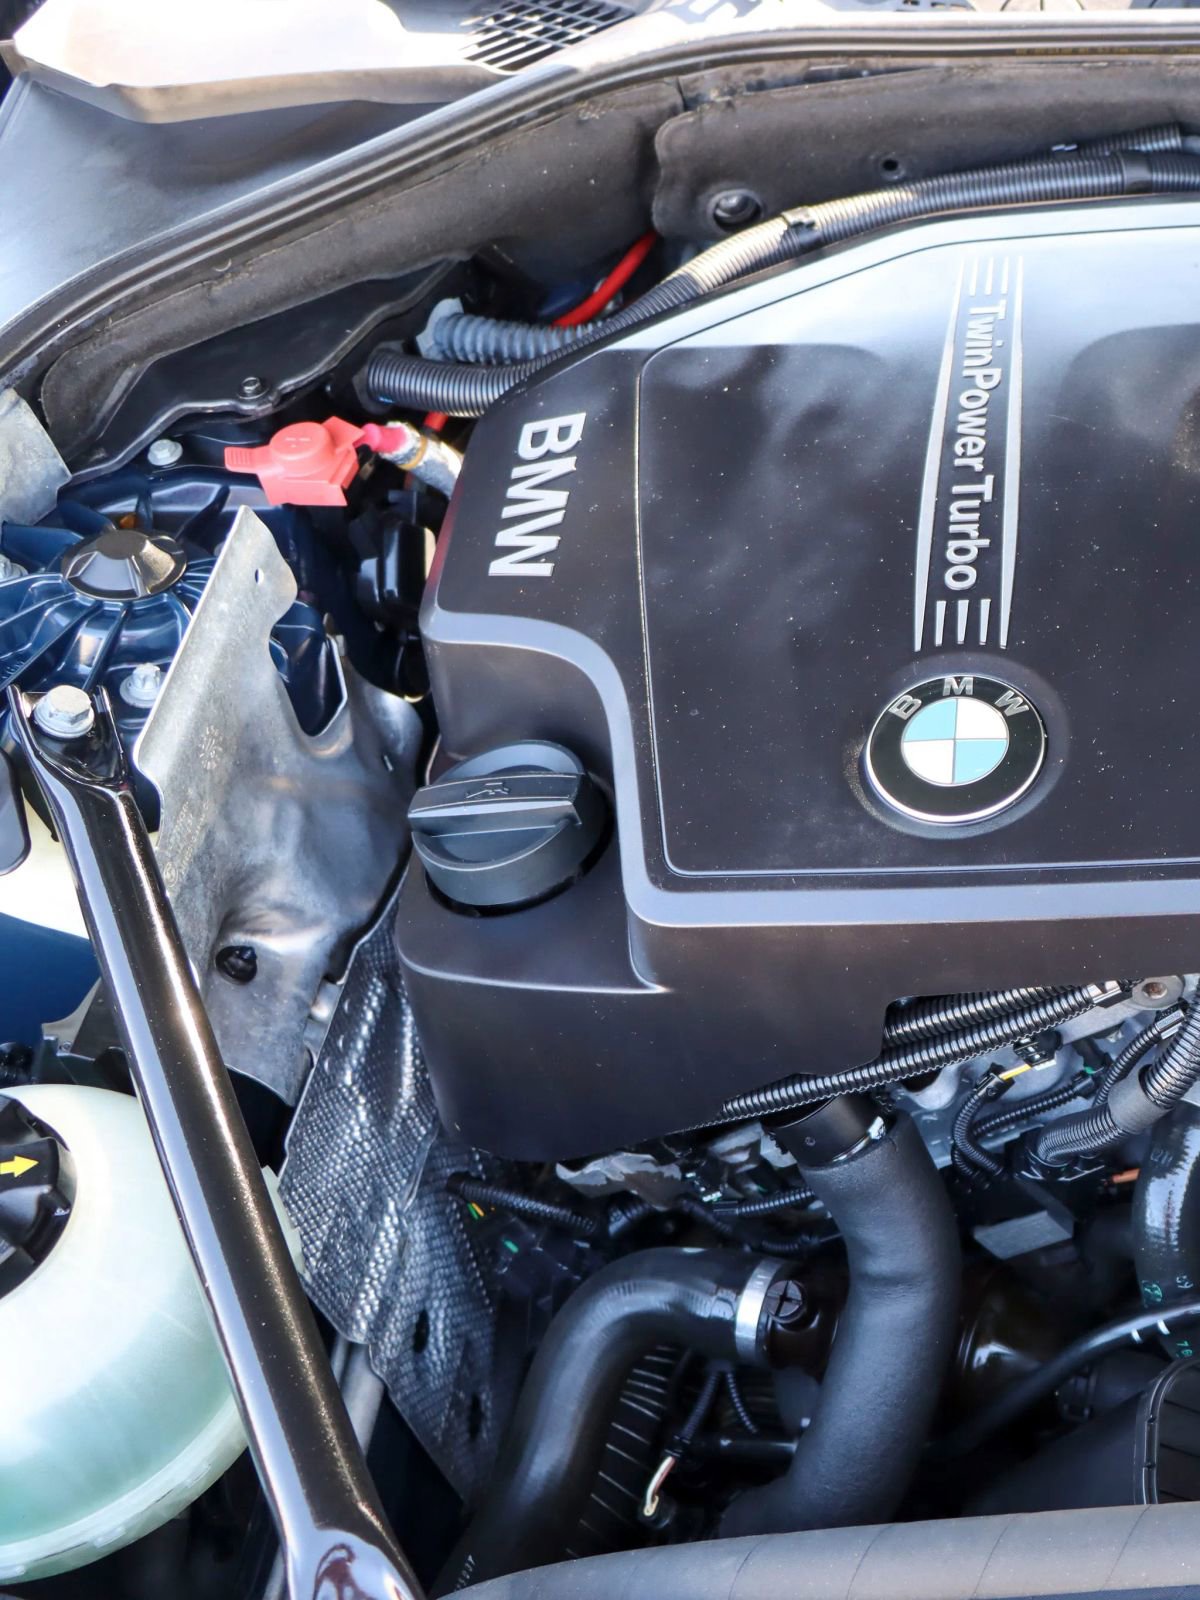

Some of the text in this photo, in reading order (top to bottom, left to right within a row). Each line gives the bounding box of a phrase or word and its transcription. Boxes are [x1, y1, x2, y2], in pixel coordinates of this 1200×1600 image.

[488, 412, 587, 577] BMW
[944, 299, 1007, 591] TwinPower Turbo
[888, 676, 1030, 721] BMW
